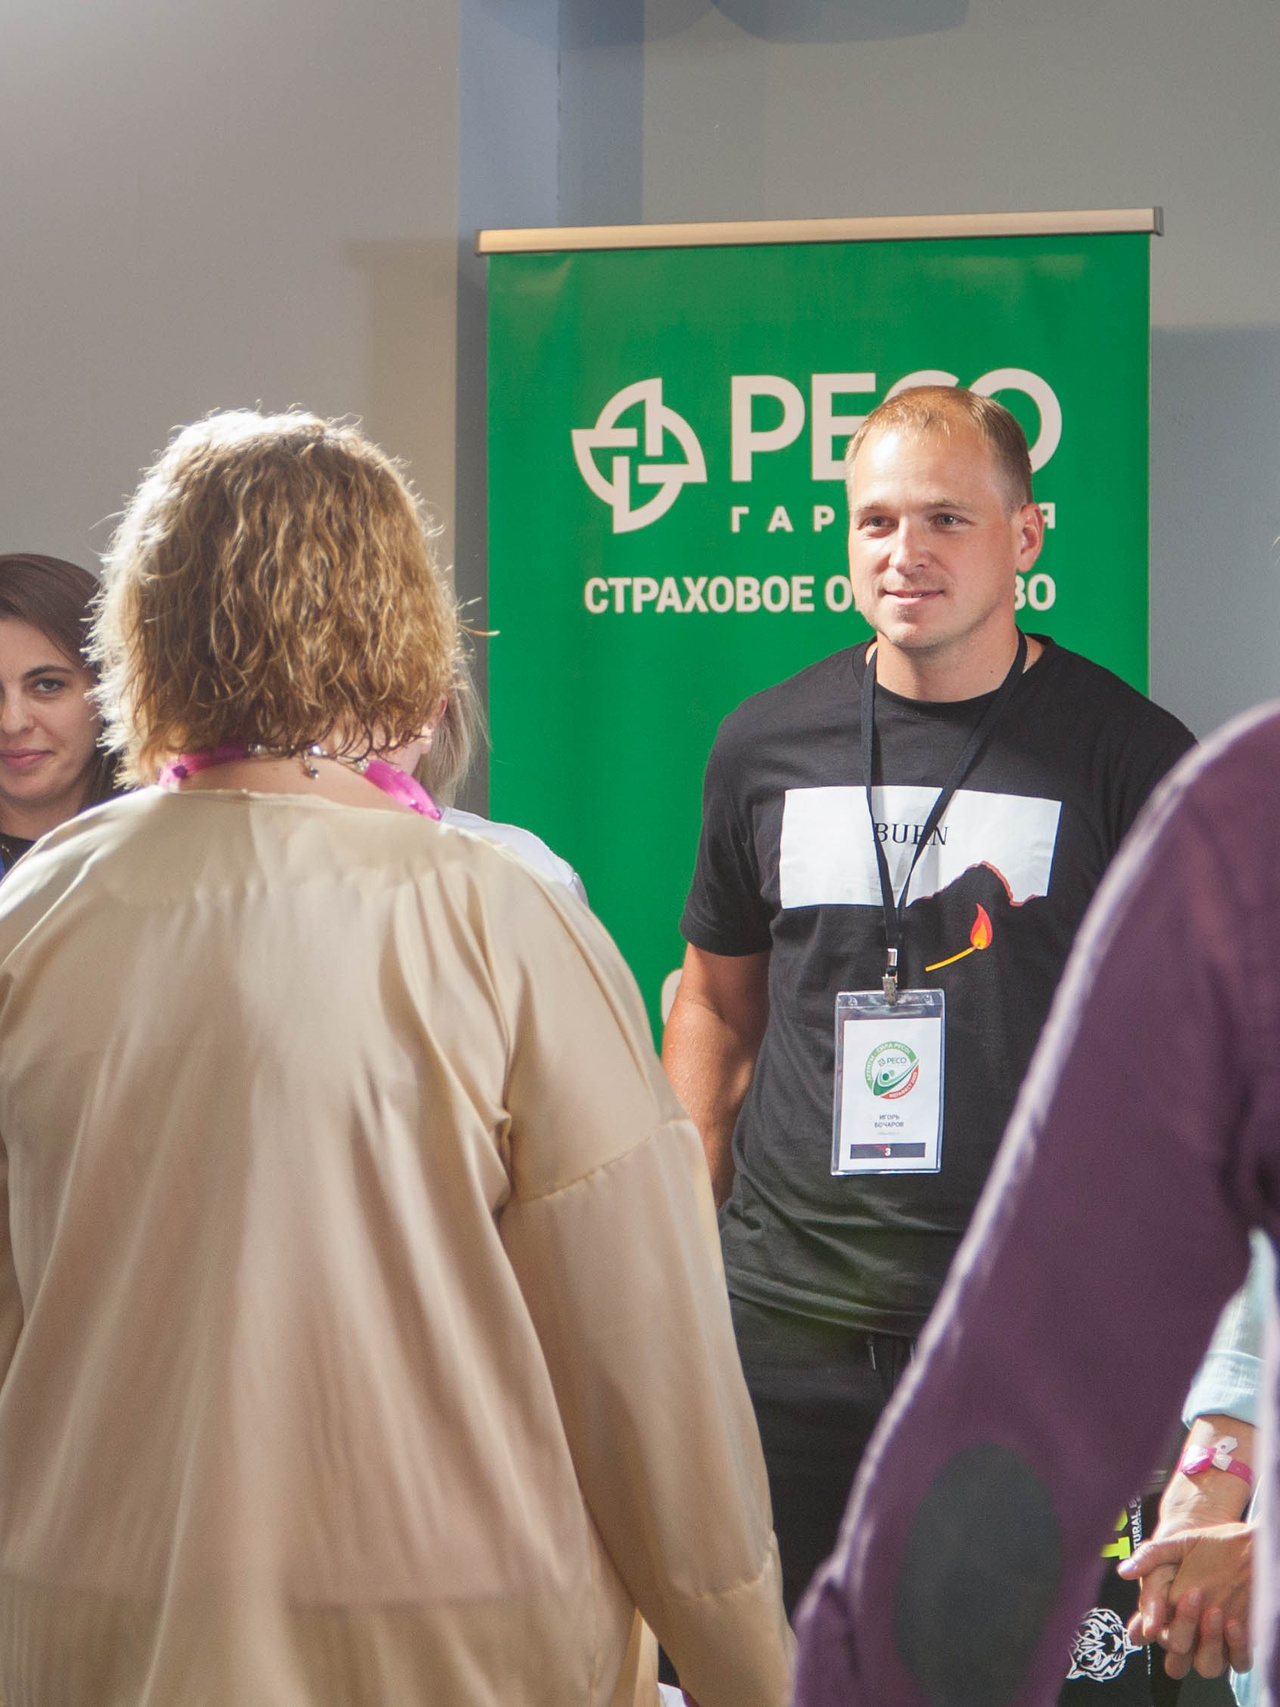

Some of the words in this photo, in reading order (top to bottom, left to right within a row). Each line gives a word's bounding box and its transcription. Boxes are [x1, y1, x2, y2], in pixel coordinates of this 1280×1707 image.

[731, 367, 1062, 482] РЕО
[584, 575, 815, 614] СТРАХОВОЕ
[886, 1057, 907, 1065] РЕСО
[884, 1147, 892, 1157] 3
